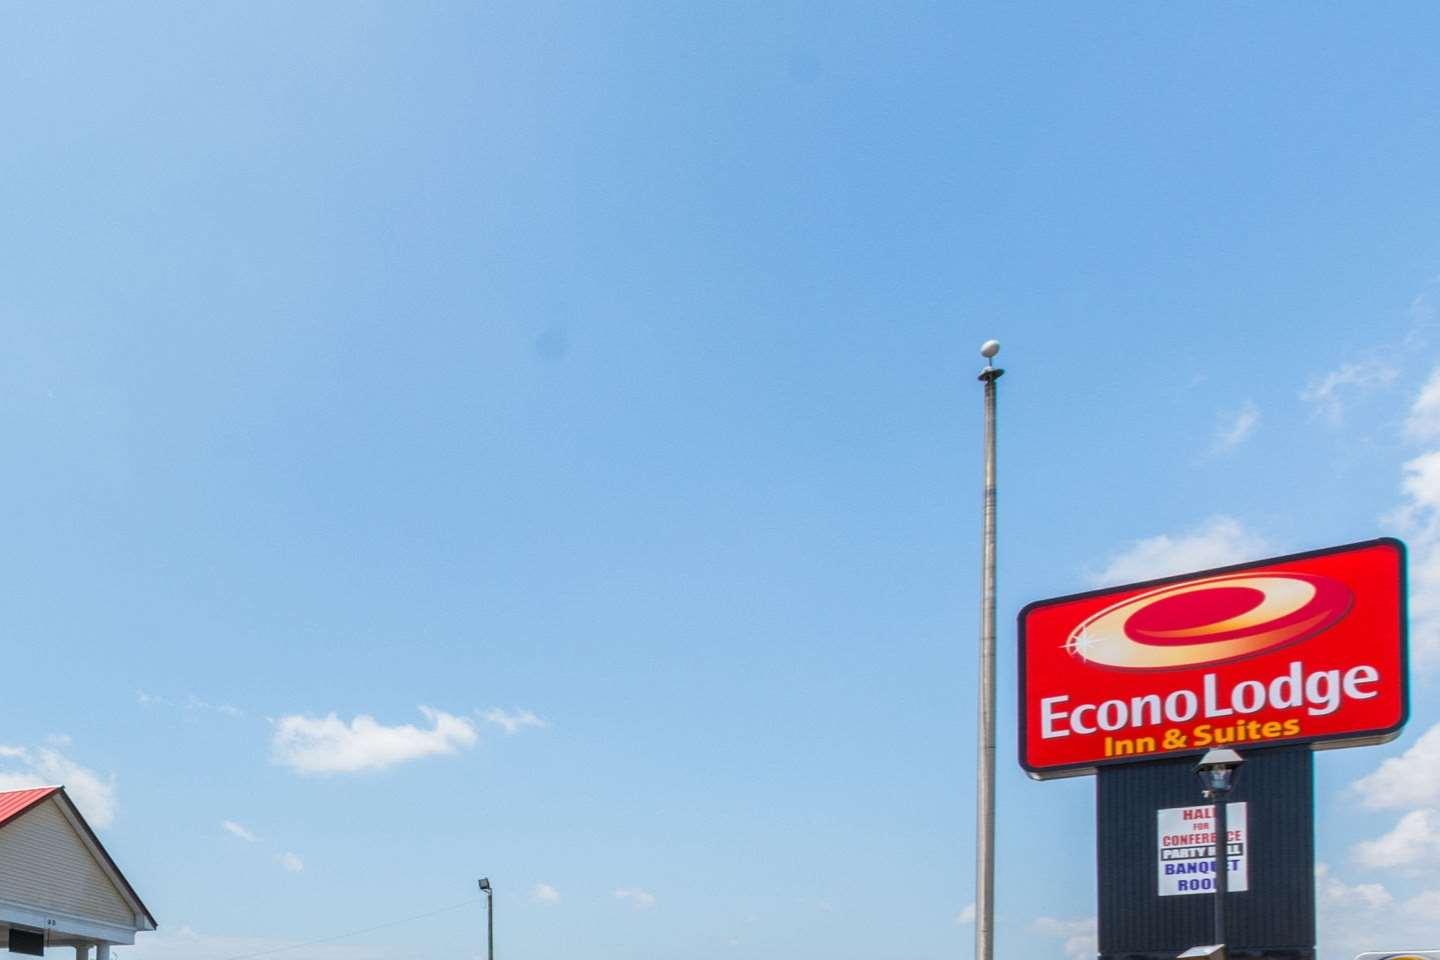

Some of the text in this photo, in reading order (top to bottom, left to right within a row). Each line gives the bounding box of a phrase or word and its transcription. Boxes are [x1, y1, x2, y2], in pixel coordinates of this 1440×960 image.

[1104, 718, 1300, 756] Inn & Suites
[1183, 808, 1217, 820] HAL
[1193, 823, 1210, 831] FOR
[1163, 831, 1241, 846] CONFERECE
[1163, 846, 1240, 859] PARTY HLL
[1178, 878, 1217, 891] ROO
